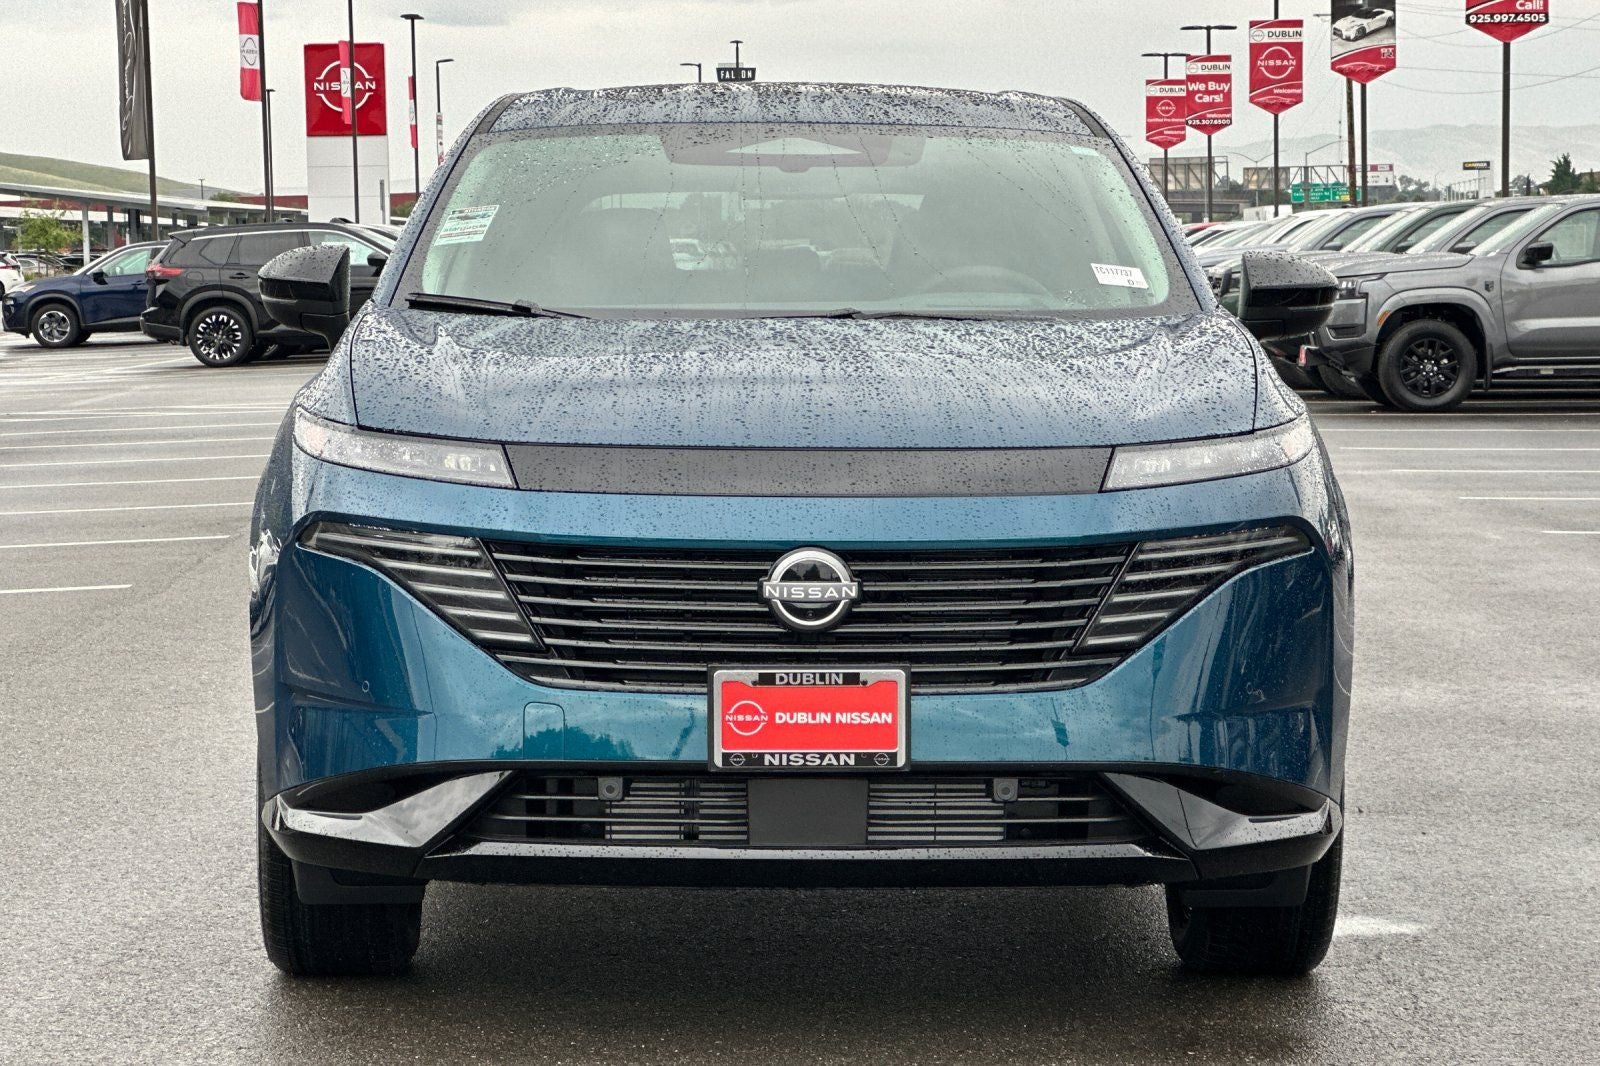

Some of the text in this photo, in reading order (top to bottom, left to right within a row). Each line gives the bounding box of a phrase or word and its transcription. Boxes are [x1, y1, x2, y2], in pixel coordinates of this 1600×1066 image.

[1516, 0, 1543, 10] Call!
[1469, 14, 1546, 23] 925.997.4505
[1267, 30, 1302, 38] DUBLIN
[720, 70, 752, 79] FALON
[313, 81, 376, 91] NISAN
[1187, 81, 1231, 93] We Buy
[1195, 94, 1223, 102] Cars!
[765, 585, 856, 598] NISSAN
[775, 673, 844, 685] DUBLIN
[775, 712, 892, 724] DUBLIN NISSAN
[764, 753, 855, 766] NISSAN
